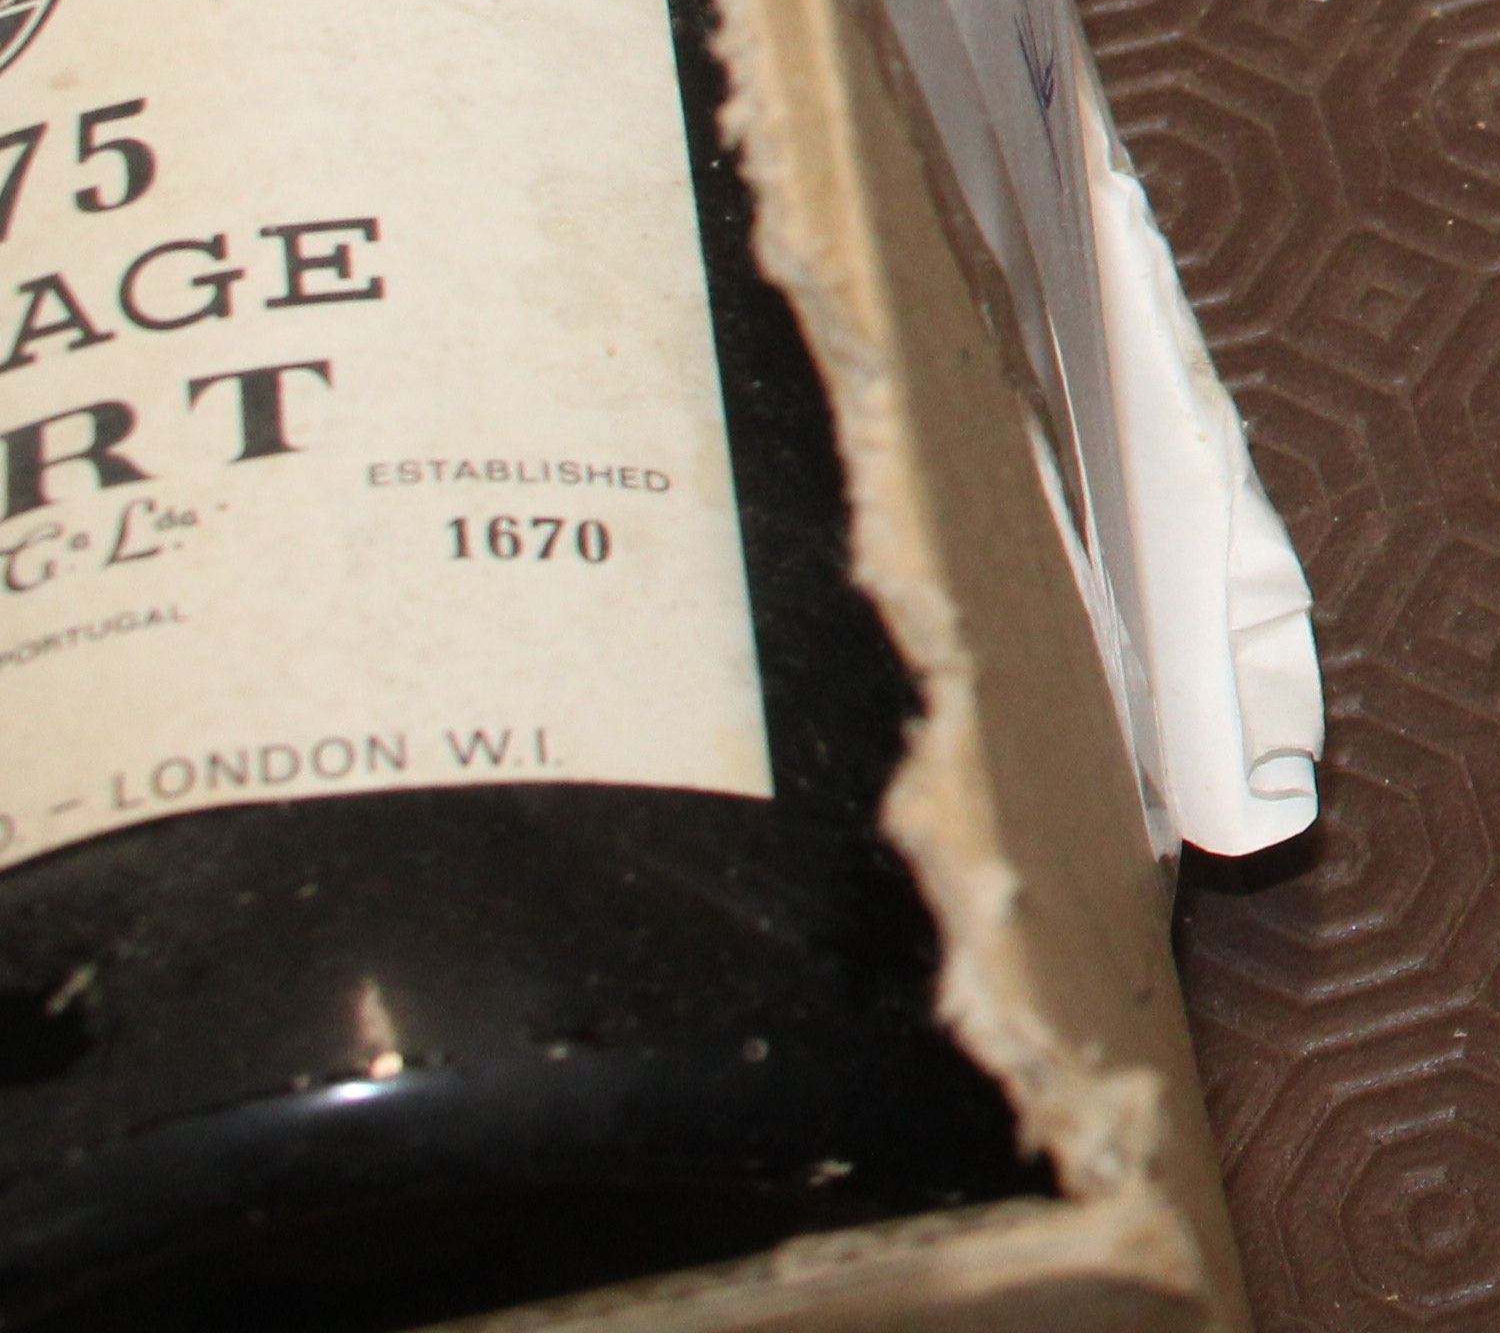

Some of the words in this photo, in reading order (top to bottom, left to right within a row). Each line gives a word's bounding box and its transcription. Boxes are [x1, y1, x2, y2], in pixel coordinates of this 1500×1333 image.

[0, 216, 387, 374] AGE
[0, 358, 335, 525] RT
[367, 458, 672, 494] ESTABLISHED
[446, 514, 613, 564] 1670
[109, 732, 409, 811] LONDON
